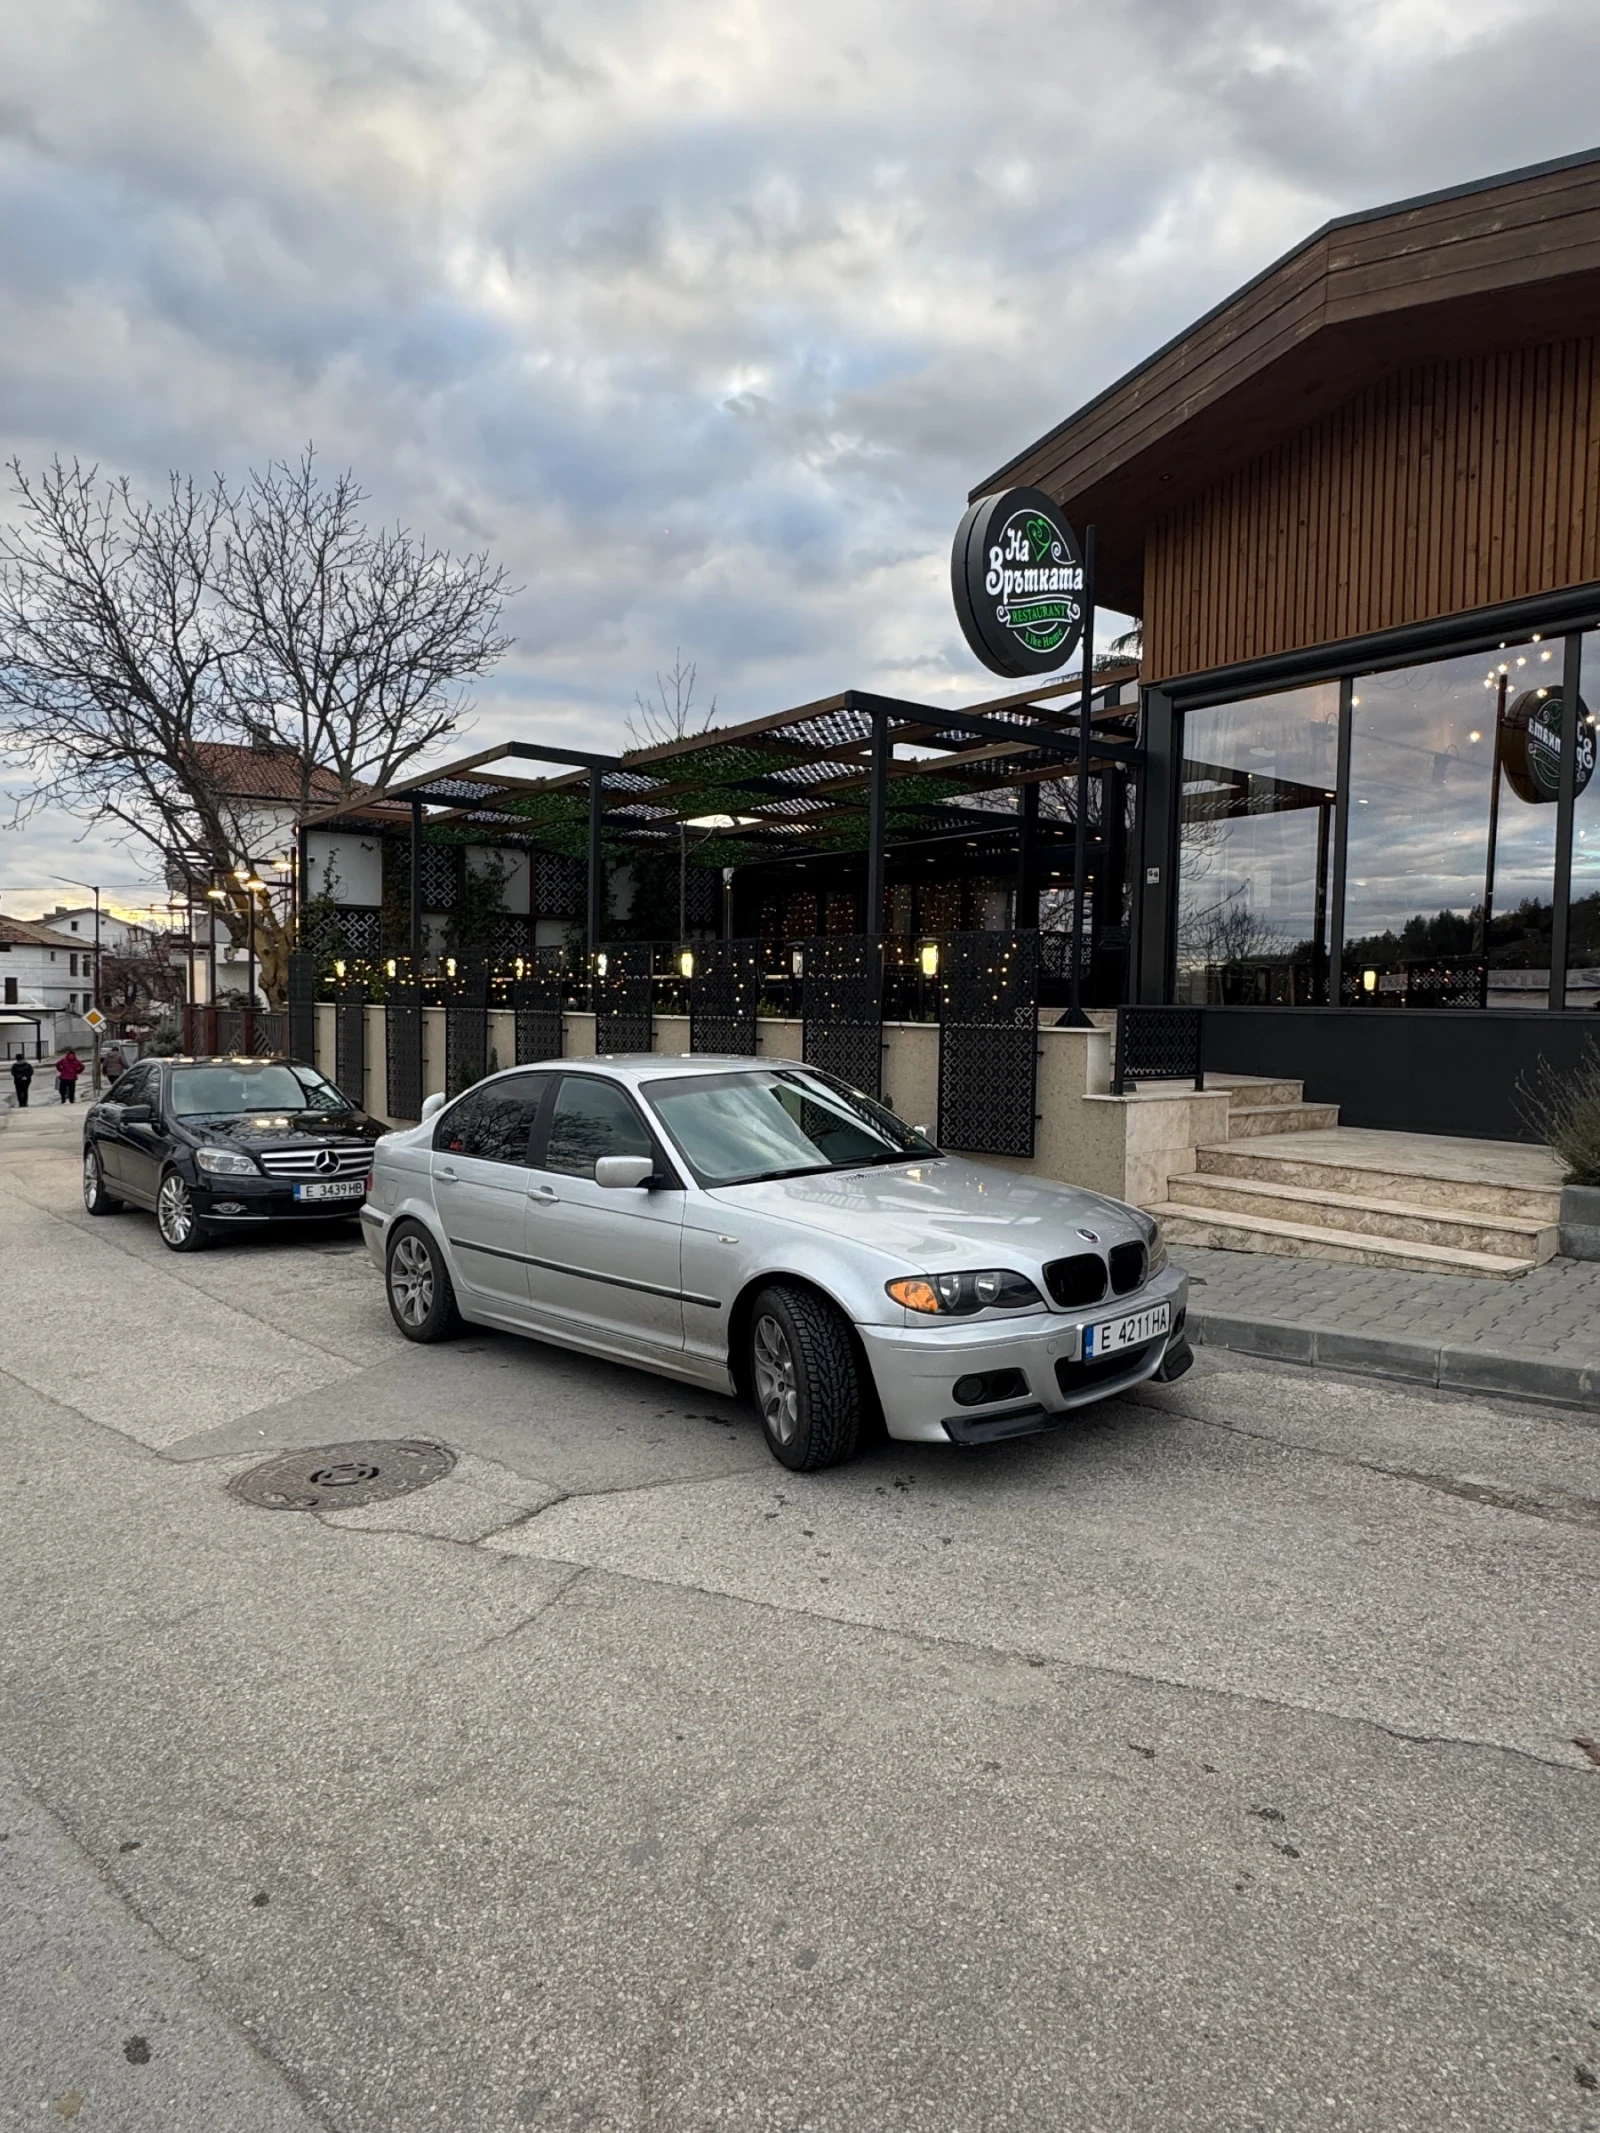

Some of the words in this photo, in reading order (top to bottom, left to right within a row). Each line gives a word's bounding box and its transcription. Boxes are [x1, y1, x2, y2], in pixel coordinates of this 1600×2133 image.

[1006, 528, 1030, 562] На
[986, 546, 1083, 605] Врътката
[1012, 604, 1066, 623] RESTAURANT
[1025, 631, 1042, 647] Like
[1042, 628, 1063, 648] Home
[306, 1186, 314, 1197] E
[1101, 1325, 1111, 1350] E
